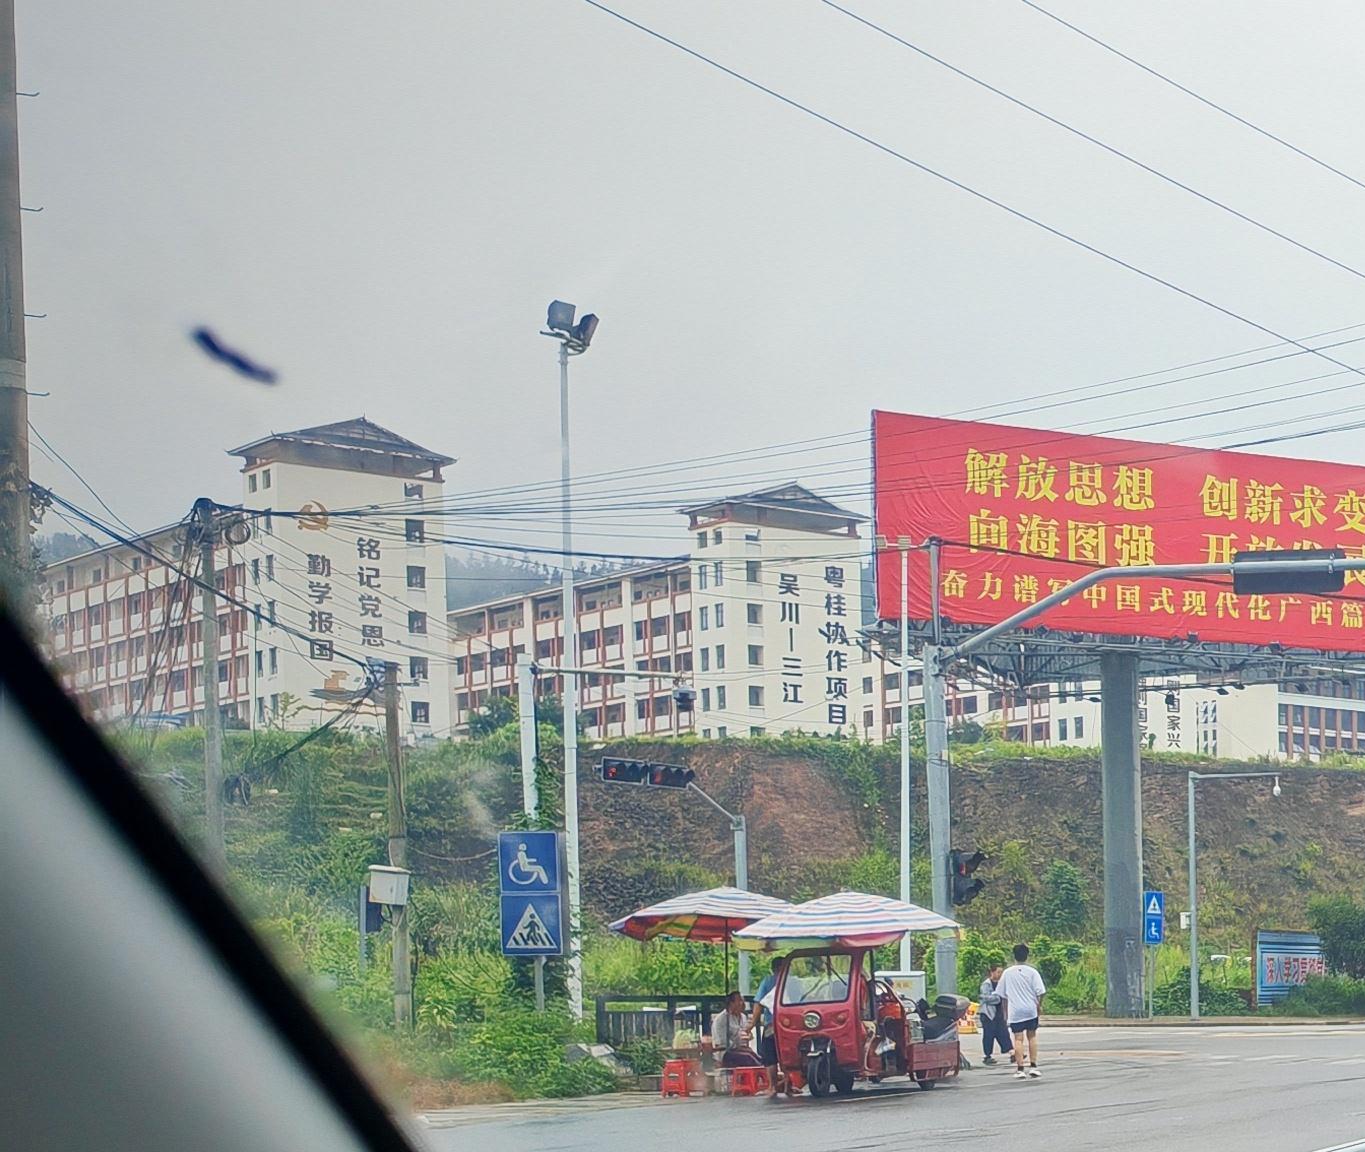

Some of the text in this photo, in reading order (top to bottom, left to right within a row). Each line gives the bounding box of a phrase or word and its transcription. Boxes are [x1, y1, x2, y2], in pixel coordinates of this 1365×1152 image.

[964, 447, 1155, 511] 解放思想
[357, 536, 385, 648] 铭记党恩
[968, 509, 1155, 568] 向海图强
[307, 553, 334, 662] 勤学报国
[823, 565, 848, 725] 粤桂协作项目
